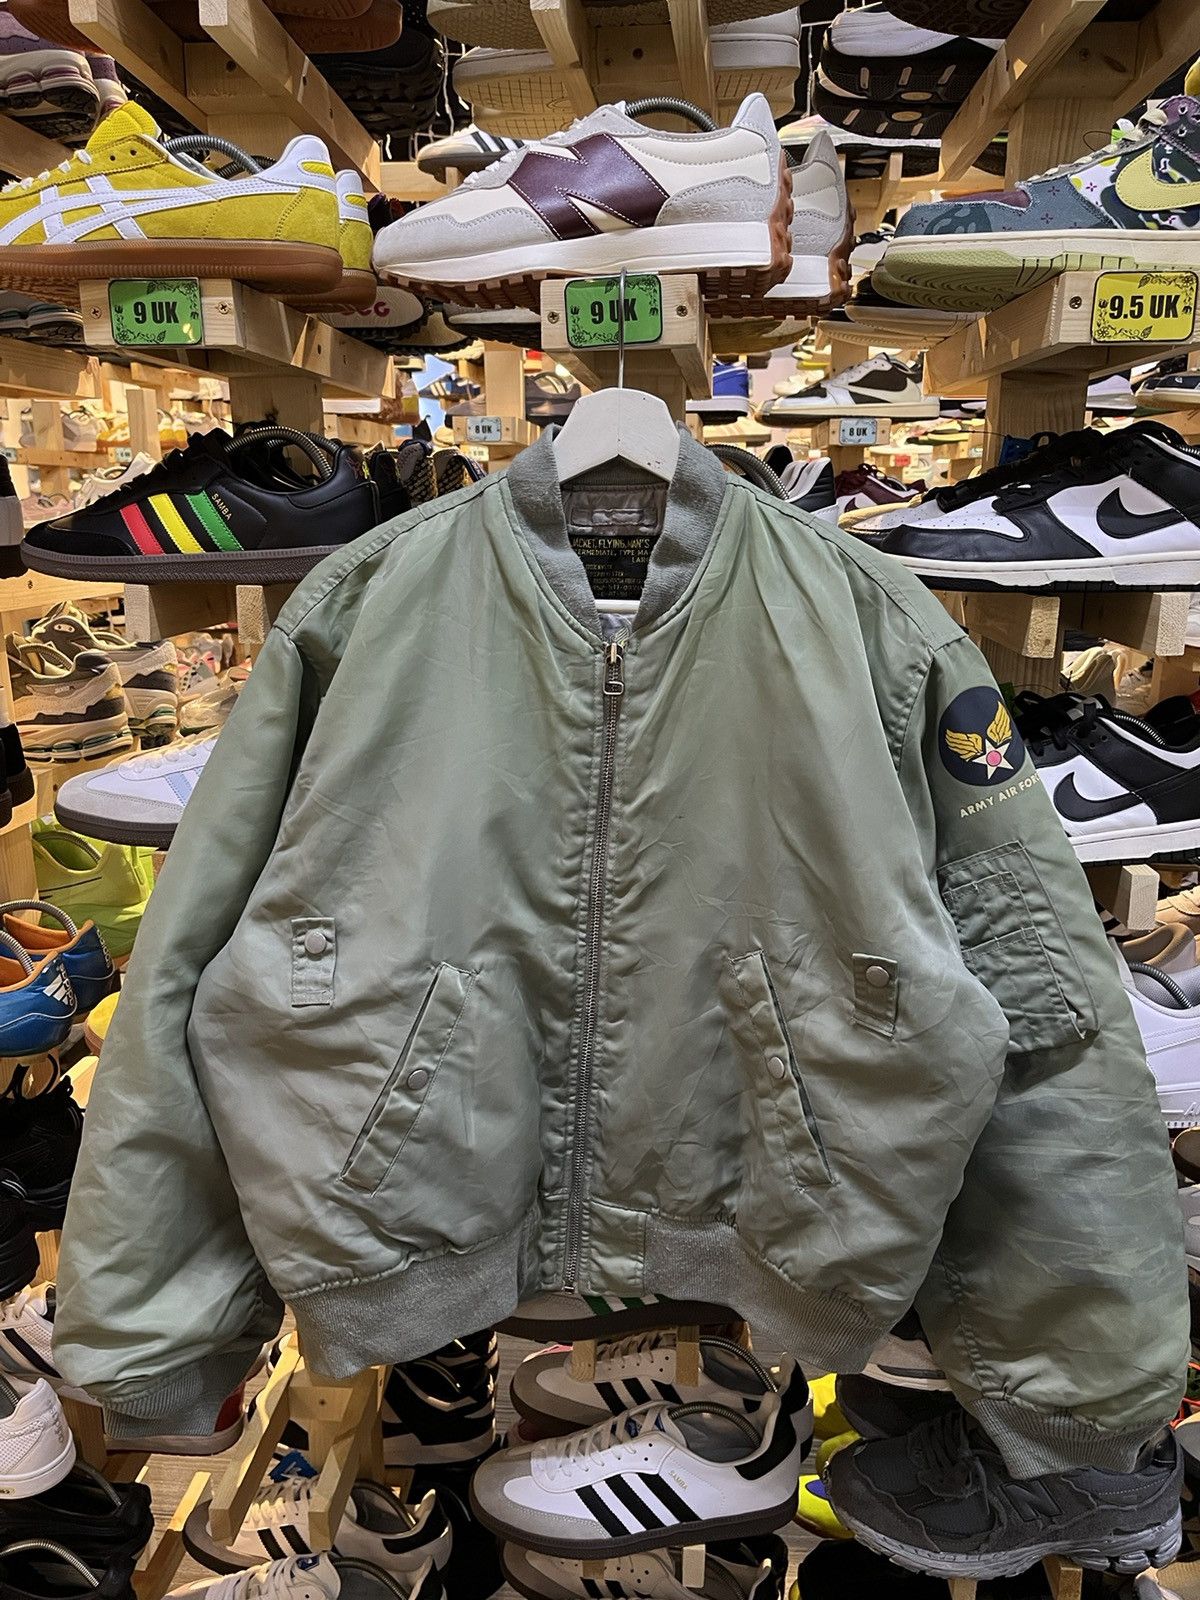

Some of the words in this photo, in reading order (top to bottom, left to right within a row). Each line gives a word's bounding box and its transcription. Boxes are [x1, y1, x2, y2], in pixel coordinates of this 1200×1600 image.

[133, 301, 147, 324] 9
[151, 301, 179, 324] UK
[590, 301, 604, 325] 9
[609, 298, 638, 323] UK
[1109, 295, 1143, 320] 9.5
[1150, 294, 1180, 319] UK
[475, 425, 480, 434] 8
[482, 425, 492, 434] UK
[849, 427, 855, 436] 8
[857, 427, 868, 436] UK
[211, 493, 232, 521] SAMBA
[960, 796, 994, 818] ARMY
[998, 786, 1019, 802] AIR
